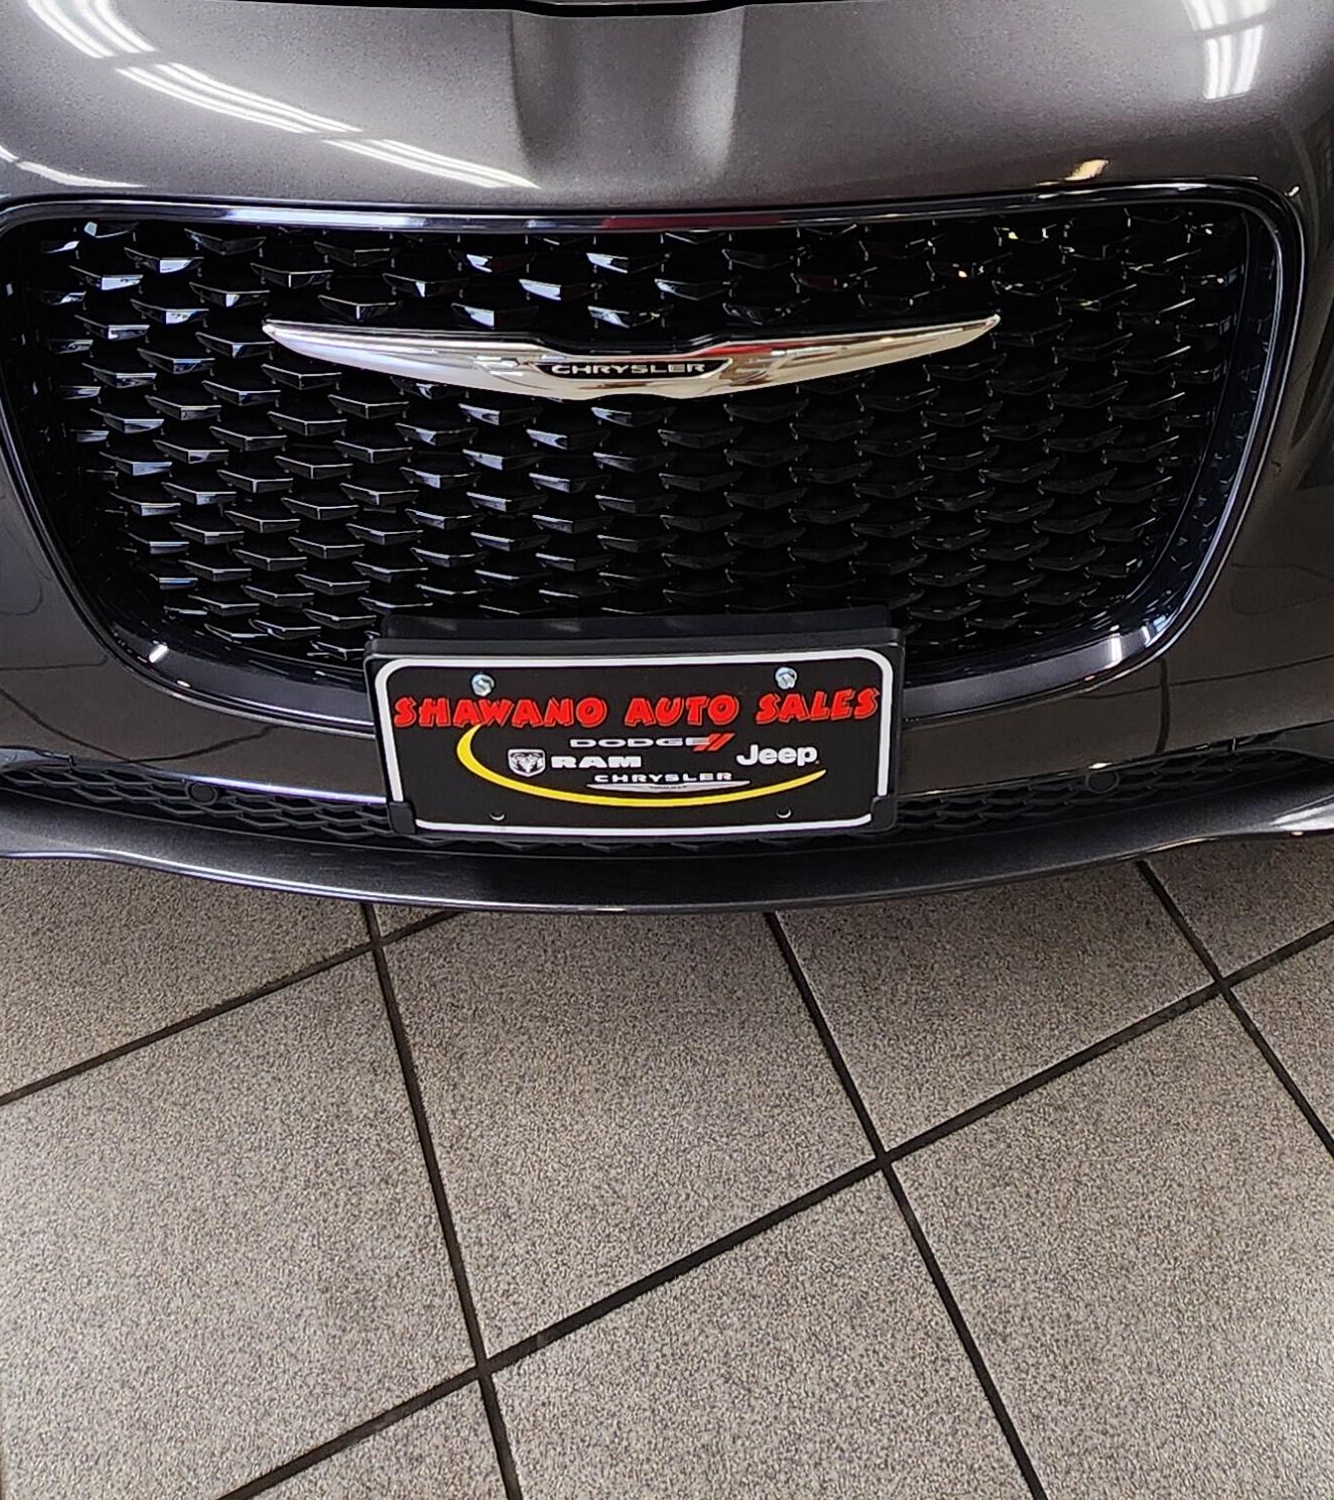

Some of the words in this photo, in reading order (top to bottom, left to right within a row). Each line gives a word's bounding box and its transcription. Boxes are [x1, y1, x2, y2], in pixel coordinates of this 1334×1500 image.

[551, 363, 706, 374] CHRYSLER
[393, 697, 608, 729] SHAWANO
[624, 694, 740, 726] AUTO
[755, 687, 880, 725] SALES
[570, 737, 711, 748] DODGE
[551, 755, 642, 768] RAM
[736, 744, 818, 767] Jeep
[594, 772, 732, 783] CHRYSLER
